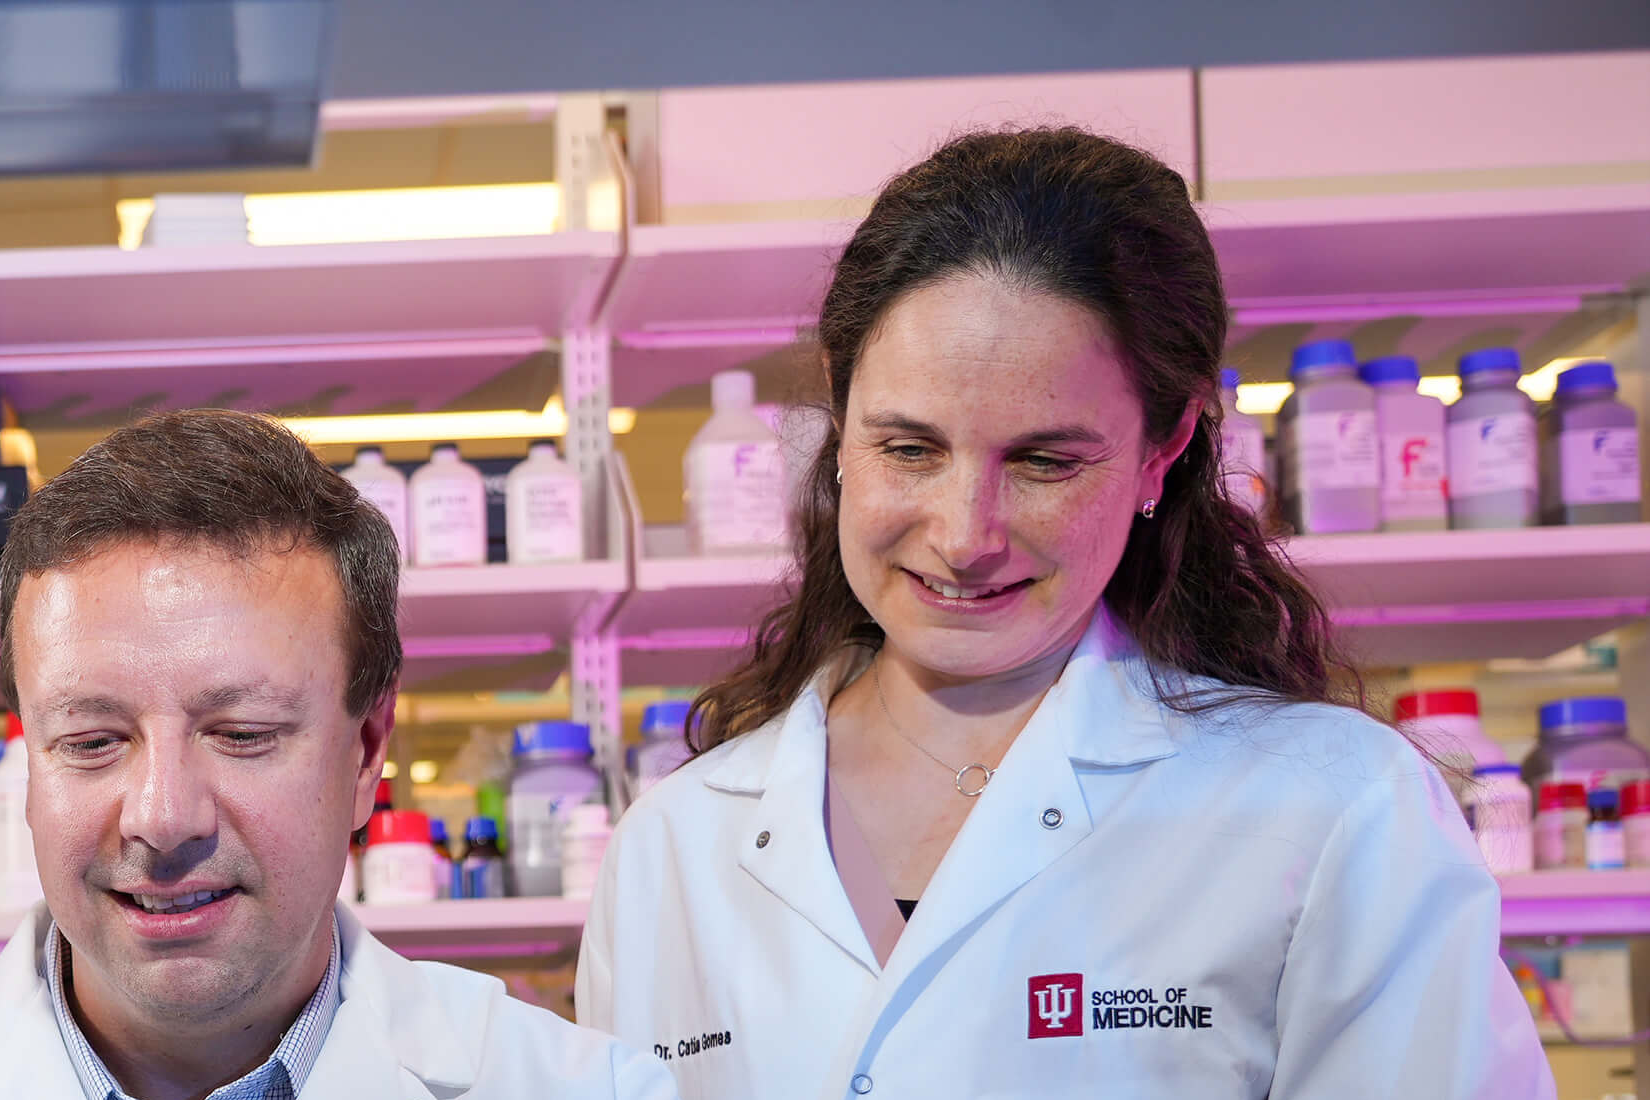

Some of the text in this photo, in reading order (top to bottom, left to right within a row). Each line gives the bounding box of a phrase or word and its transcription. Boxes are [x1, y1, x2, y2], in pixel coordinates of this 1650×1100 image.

[1091, 987, 1187, 1006] SCHOOL OF
[1092, 1005, 1212, 1030] MEDICINE
